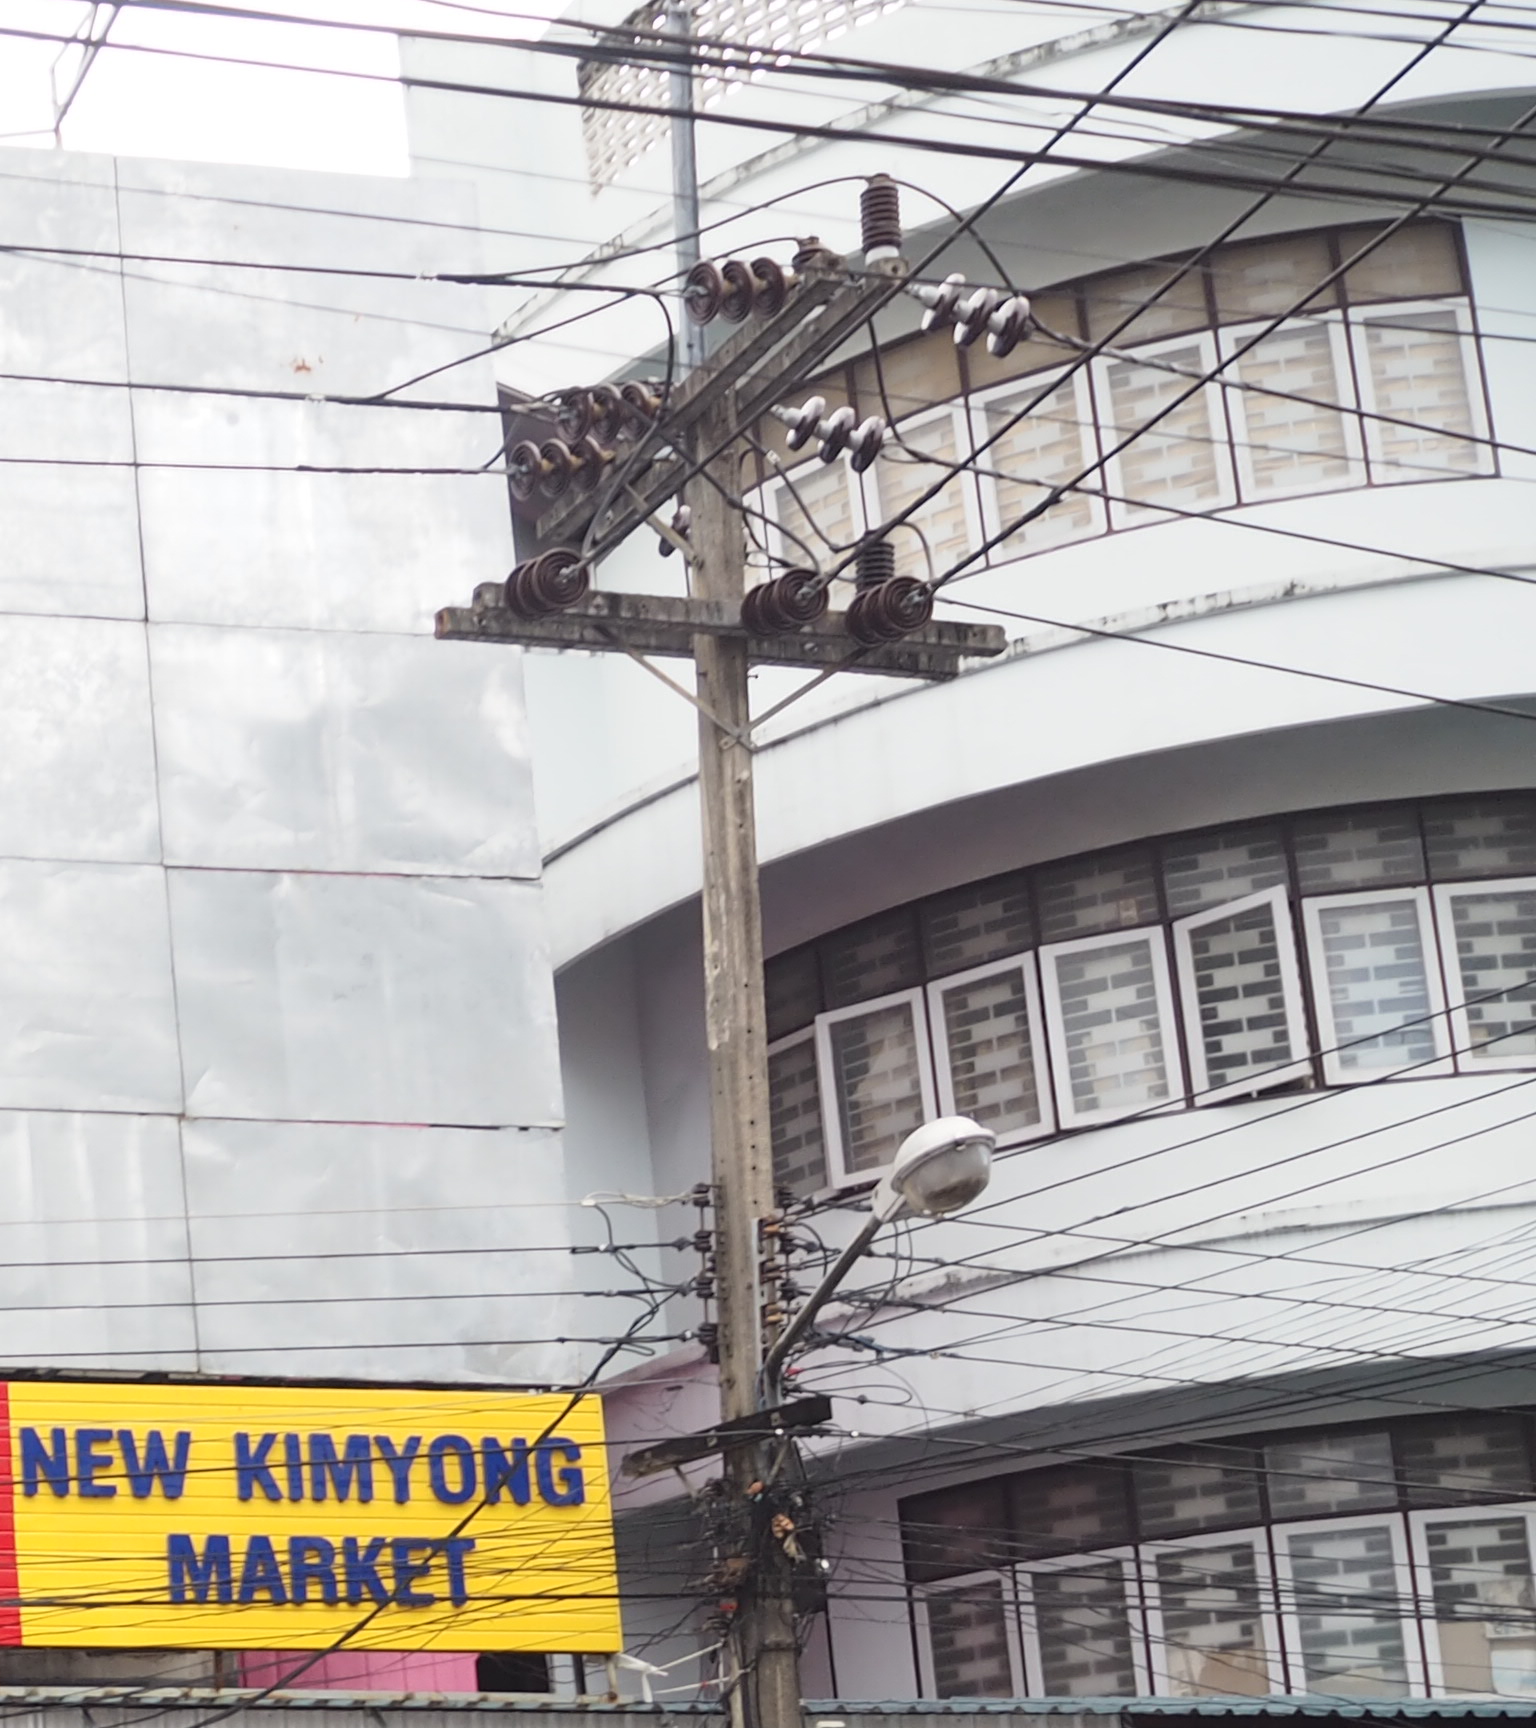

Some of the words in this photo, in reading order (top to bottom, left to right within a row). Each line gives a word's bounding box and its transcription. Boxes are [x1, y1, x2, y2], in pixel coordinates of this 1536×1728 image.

[19, 1427, 191, 1499] NEW
[234, 1431, 585, 1507] KIMYONG
[167, 1533, 476, 1607] MARKET
